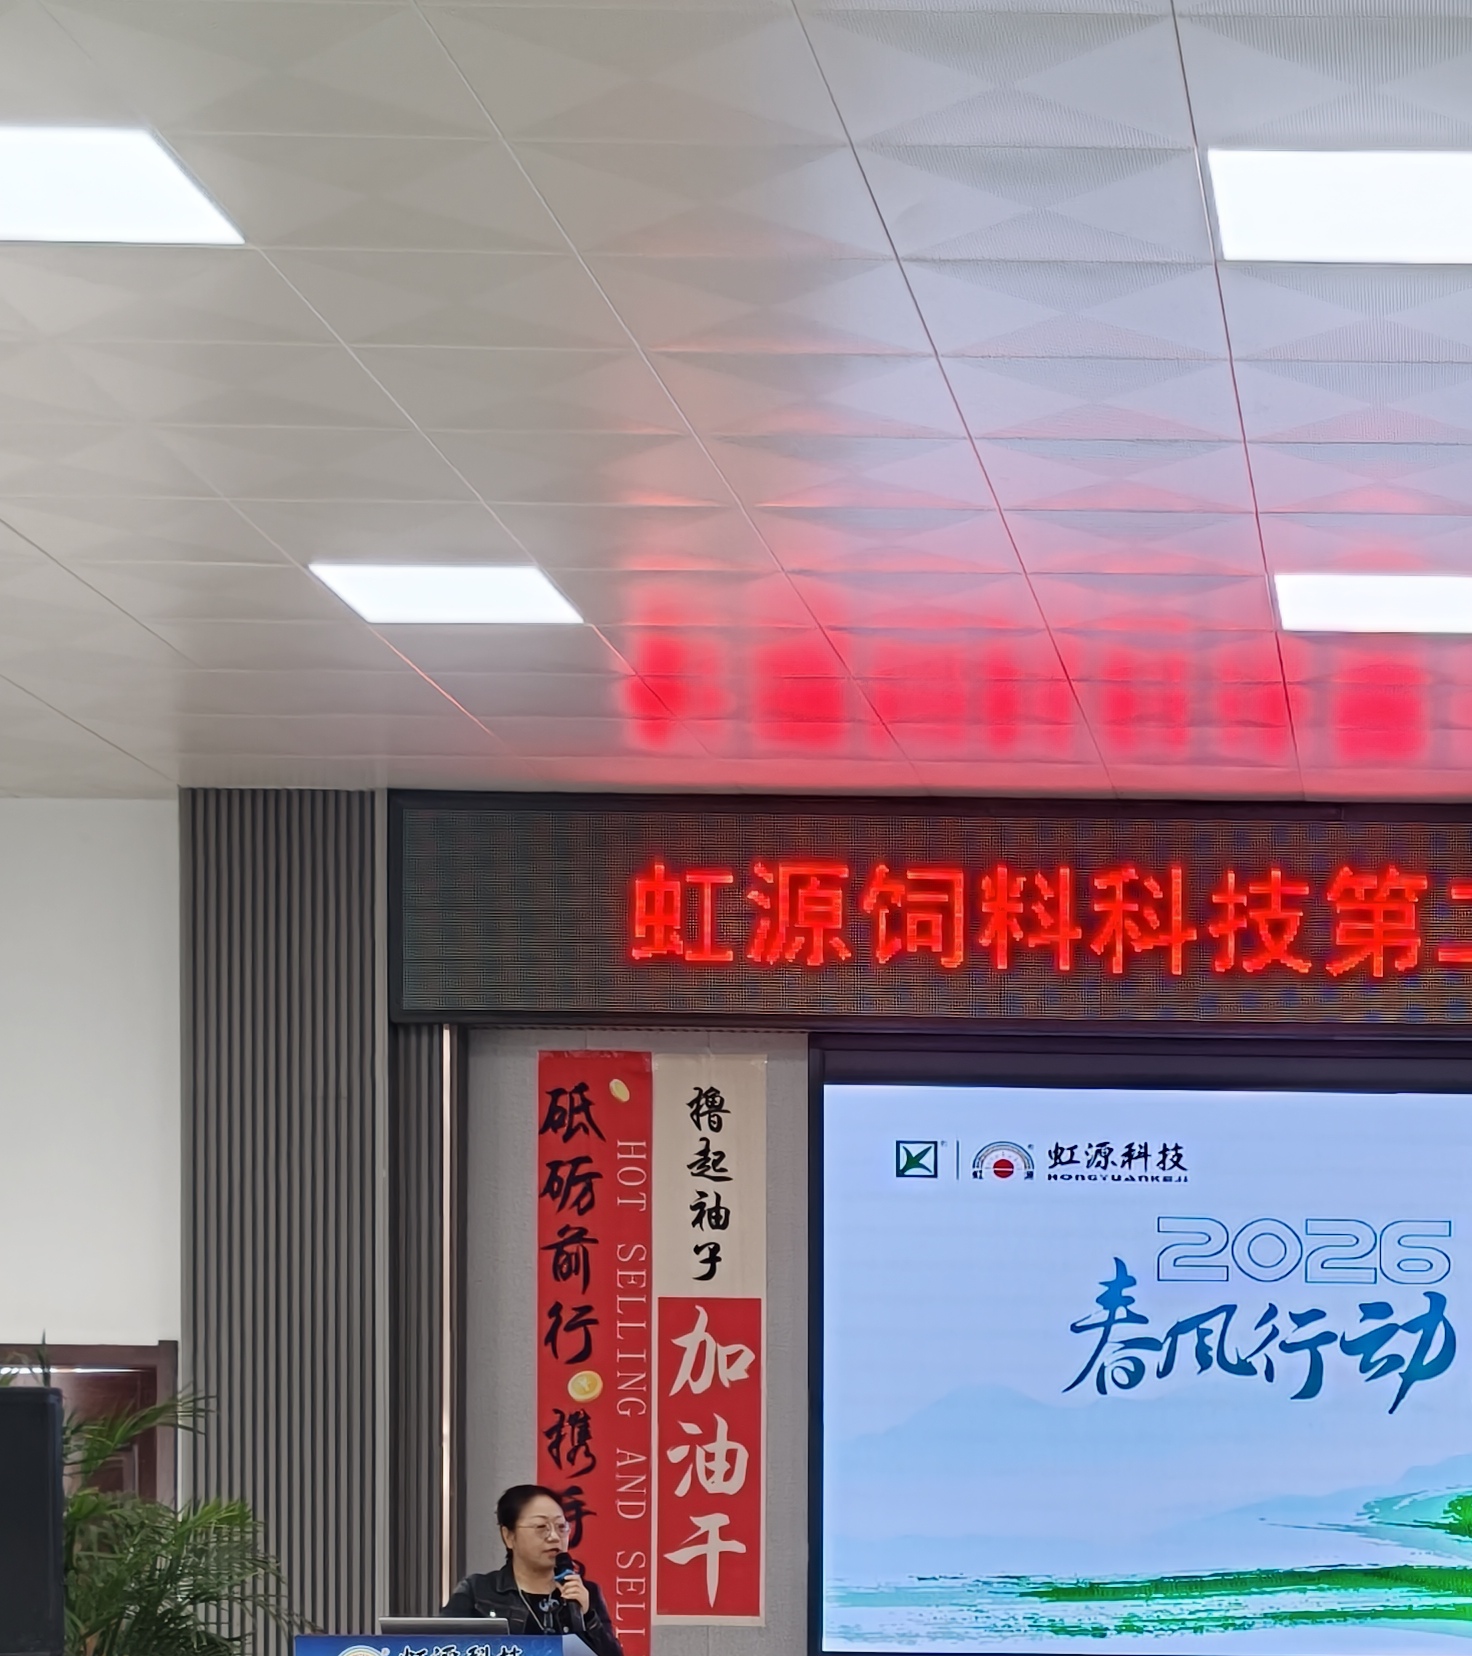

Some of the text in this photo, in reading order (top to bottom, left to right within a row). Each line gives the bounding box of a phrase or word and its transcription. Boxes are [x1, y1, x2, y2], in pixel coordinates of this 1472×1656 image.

[539, 1081, 606, 1364] 砥砺前行
[616, 1140, 647, 1211] HOT
[686, 1086, 733, 1281] 撸起袖子
[1047, 1141, 1188, 1172] 虹源科技
[1157, 1216, 1452, 1284] 2026
[616, 1244, 647, 1417] SELLING
[1062, 1257, 1457, 1414] 春风行动
[615, 1448, 647, 1520] AND
[663, 1304, 756, 1608] 加油干
